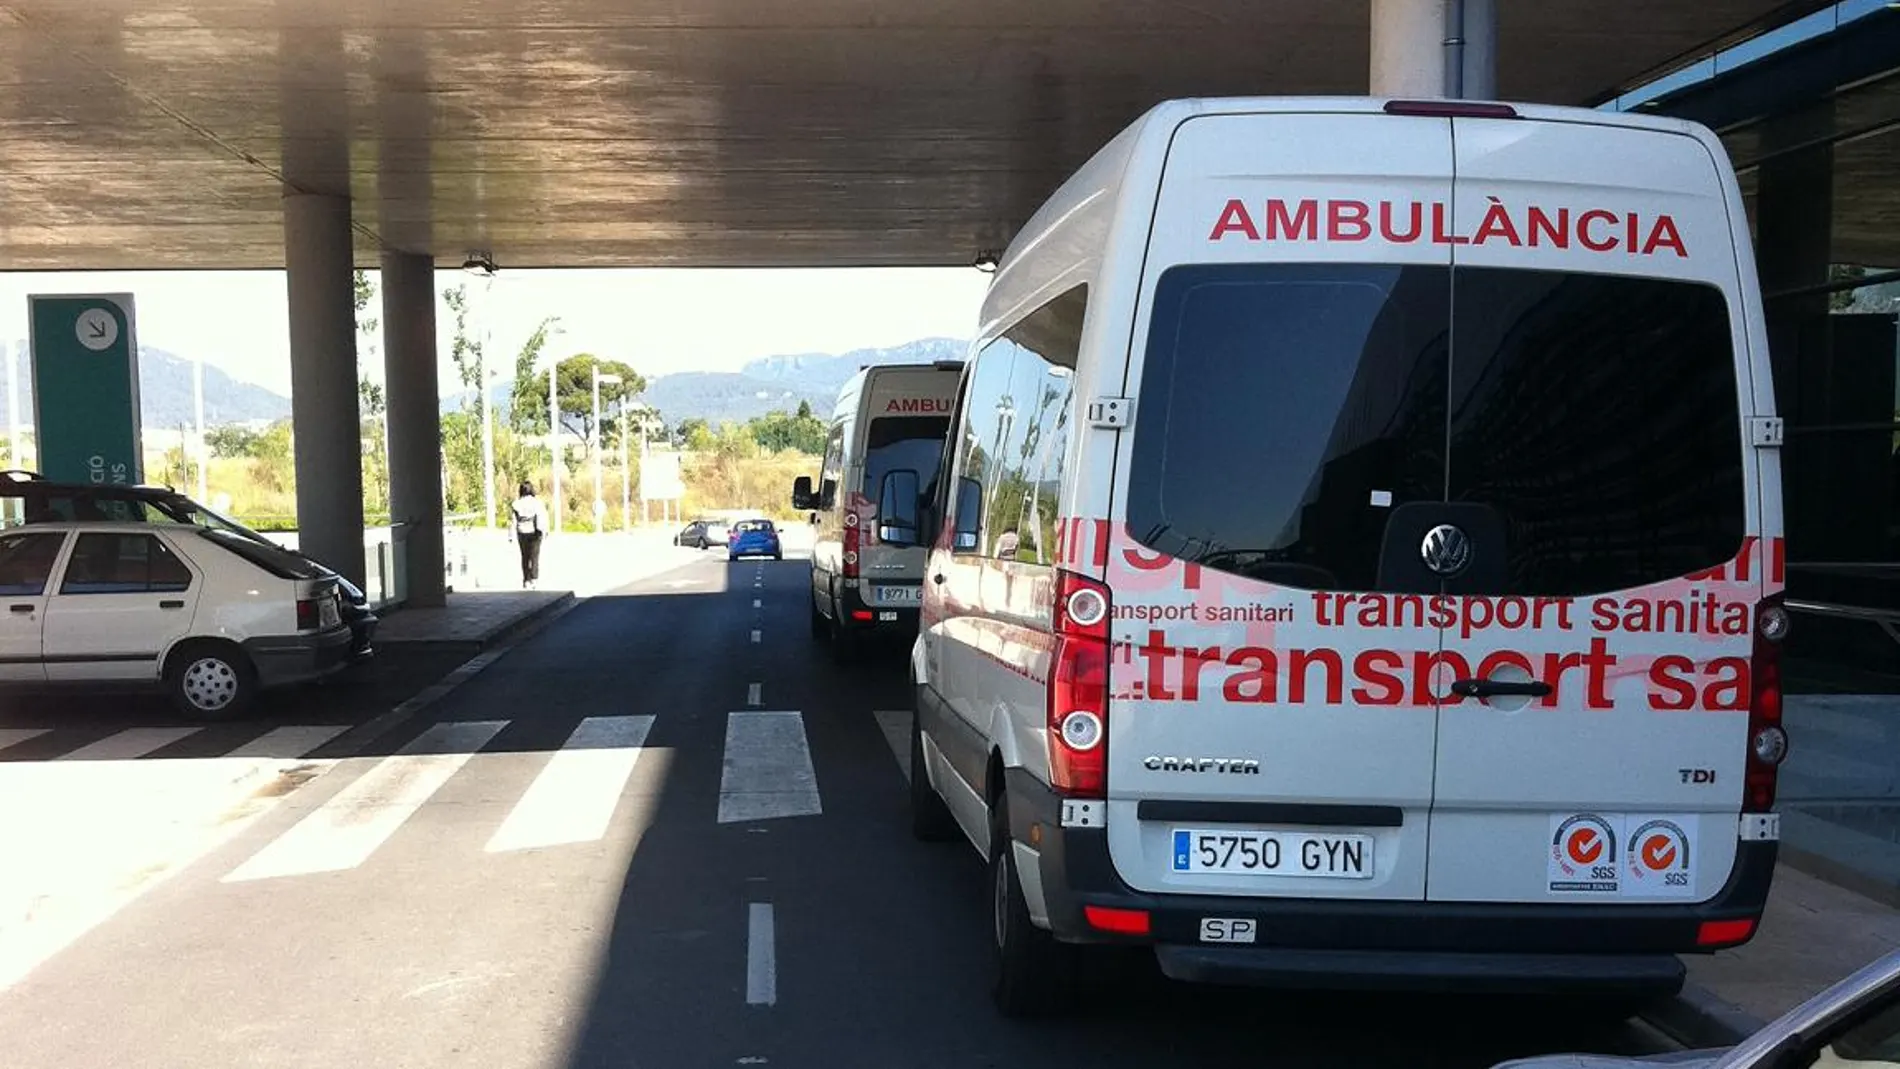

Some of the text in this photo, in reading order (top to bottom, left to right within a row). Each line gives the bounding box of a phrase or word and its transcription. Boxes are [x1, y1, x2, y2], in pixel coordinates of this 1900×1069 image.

[1209, 196, 1688, 258] AMBULÀNCIA
[1205, 603, 1294, 622] sanitari
[1311, 589, 1749, 639] transport sanita
[1648, 655, 1749, 712] sa
[1144, 756, 1260, 774] CRAFTER
[1678, 769, 1716, 784] TDI
[1199, 836, 1281, 869] 5750
[1302, 840, 1363, 872] GYN
[1591, 866, 1615, 879] SGS
[1665, 871, 1688, 885] SGS
[1206, 919, 1252, 940] SP
